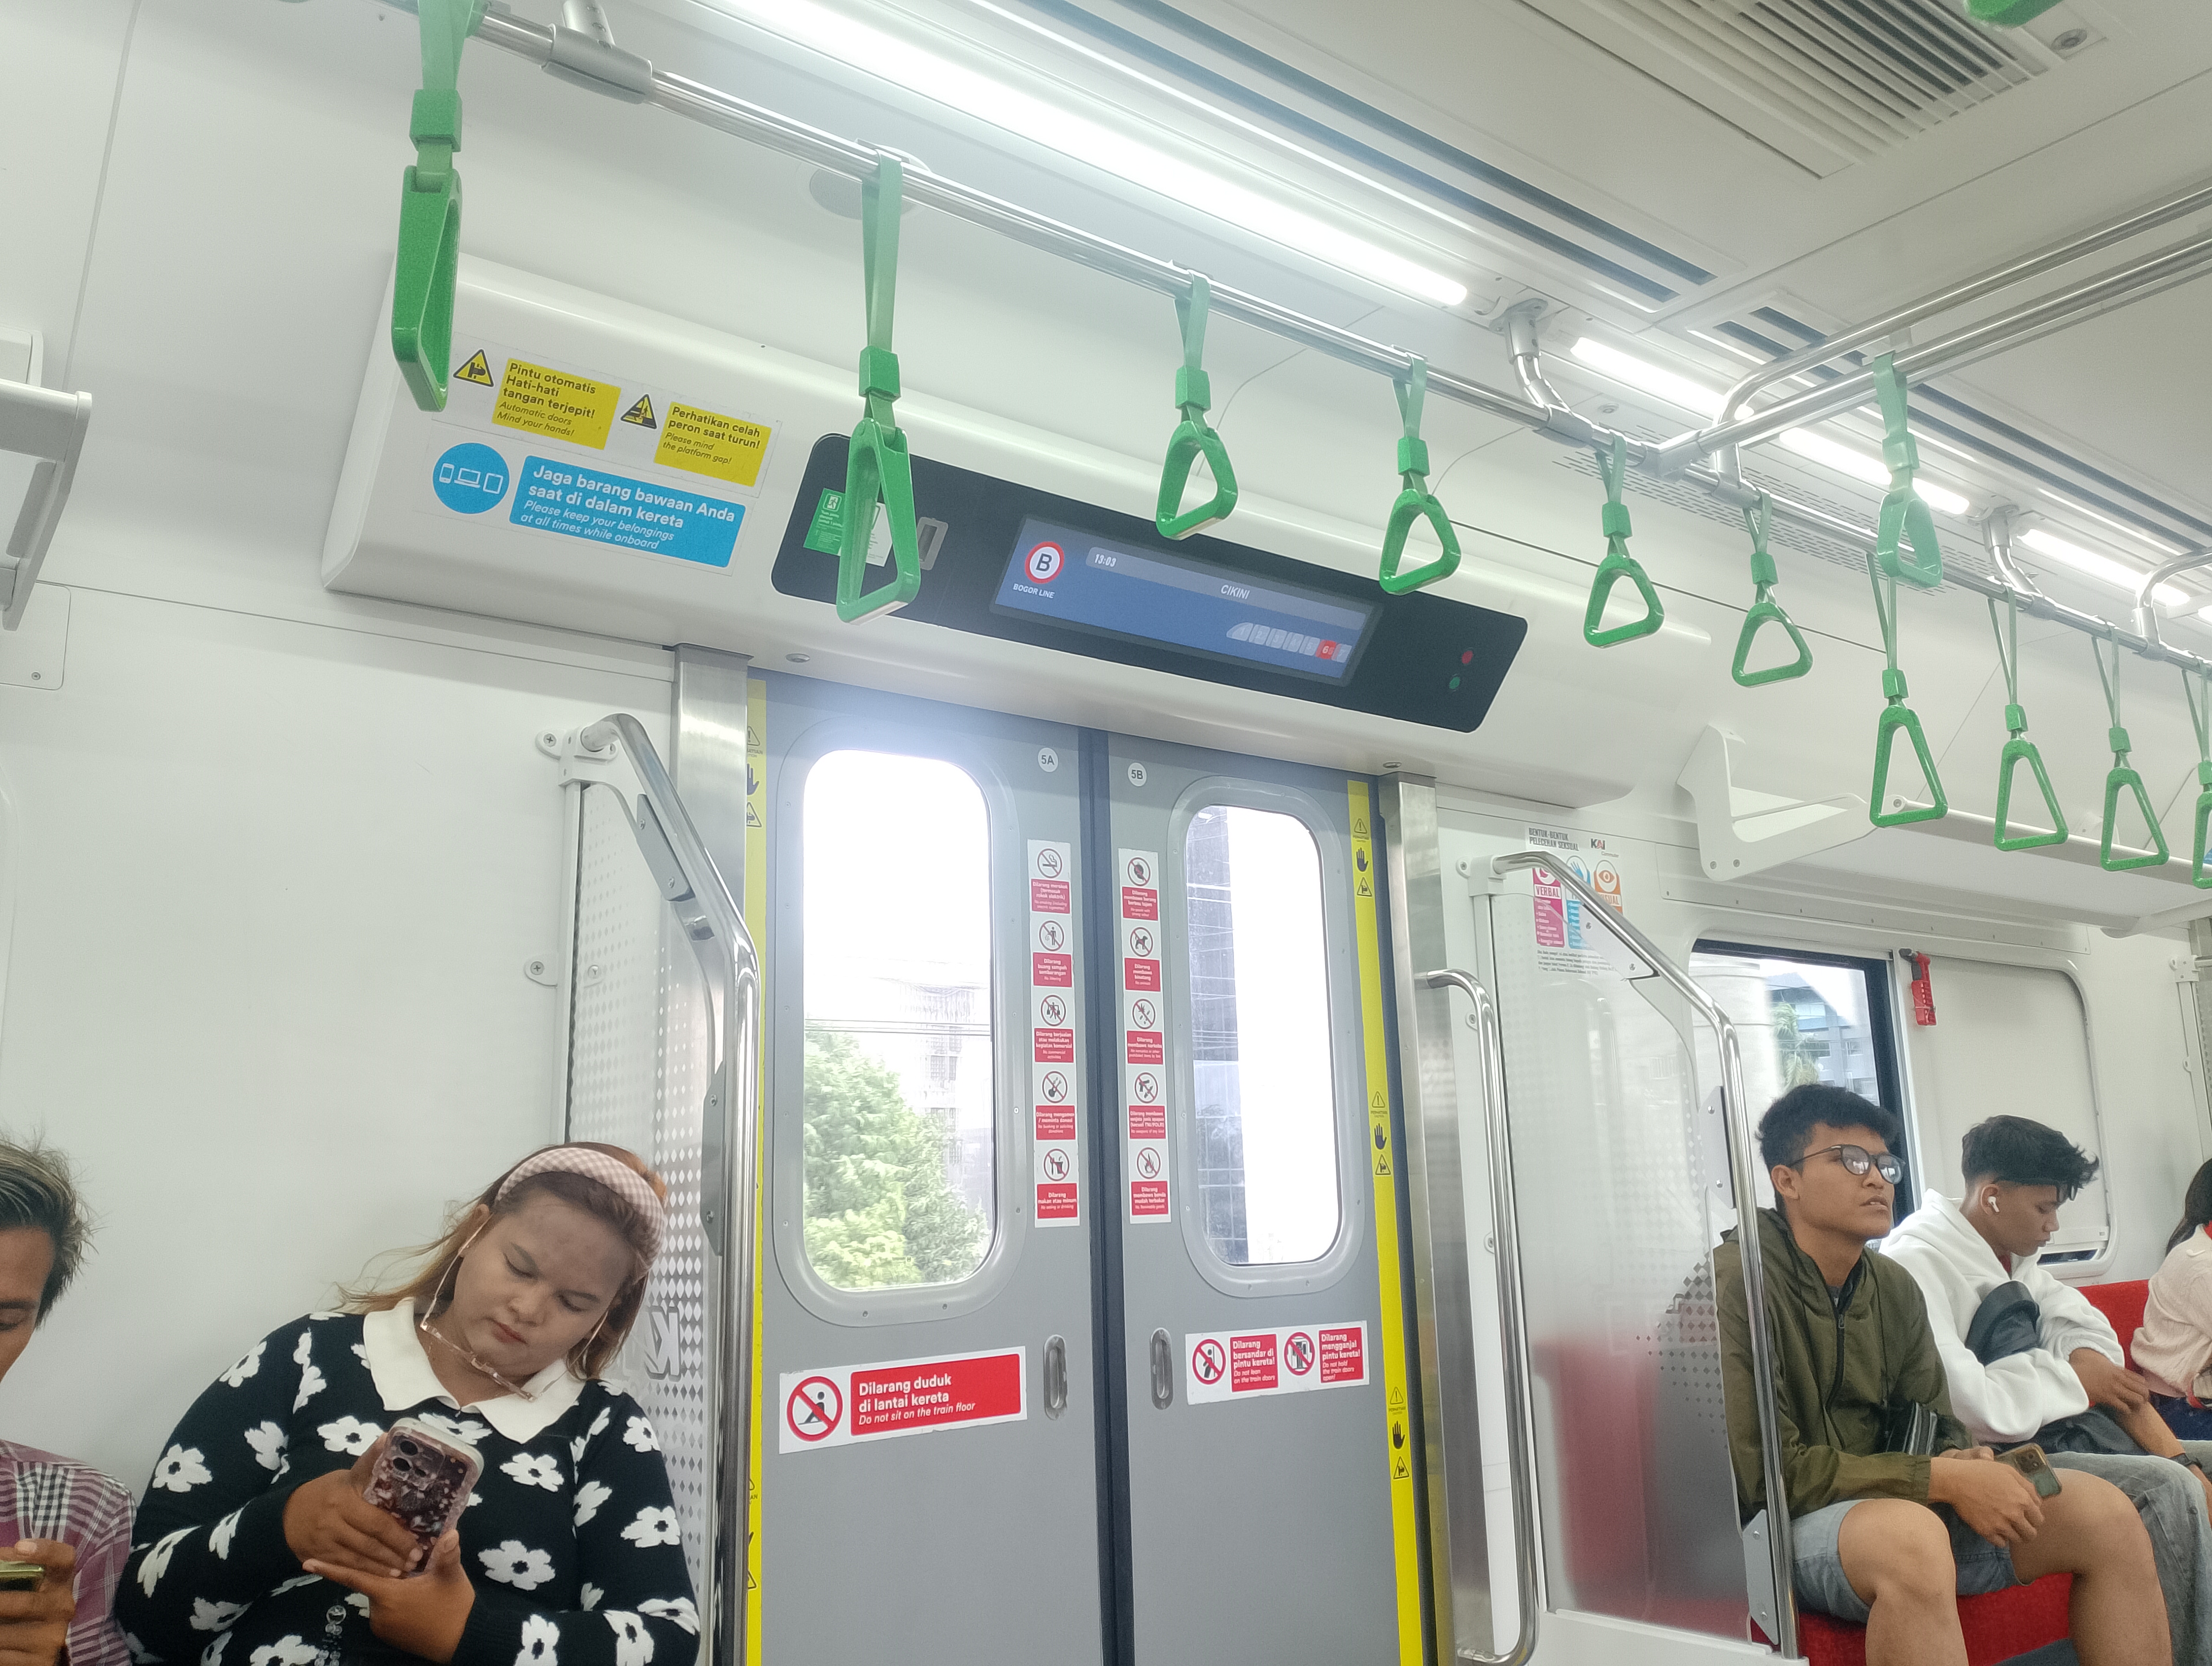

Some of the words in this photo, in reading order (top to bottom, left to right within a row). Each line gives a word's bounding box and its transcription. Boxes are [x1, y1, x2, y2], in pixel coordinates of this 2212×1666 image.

[506, 375, 560, 396] Hati-hati
[510, 363, 541, 380] Pintu
[544, 375, 596, 394] otomatis
[503, 387, 544, 406] tangan
[548, 399, 595, 419] terjepit!
[499, 401, 545, 419] Automatic
[548, 413, 573, 425] doors
[672, 407, 729, 430] Perhatikan
[732, 425, 760, 437] celah
[497, 412, 522, 423] Mind
[522, 420, 543, 428] your
[544, 423, 575, 437] hands!
[665, 432, 692, 445] Please
[693, 441, 715, 450] mind
[668, 420, 700, 434] peron
[703, 429, 725, 440] saat
[728, 434, 760, 449] turun!
[663, 442, 676, 450] the
[677, 446, 711, 459] platform
[712, 455, 732, 464] gap!
[533, 465, 573, 485] Jaga
[576, 474, 631, 501] barang
[635, 488, 693, 512] bawaan
[696, 502, 735, 522] Anda
[529, 486, 562, 501] saat
[566, 491, 582, 505] di
[586, 496, 632, 517] dalam
[635, 506, 683, 528] kereta
[524, 500, 561, 516] Please
[563, 509, 590, 523] keep
[591, 516, 616, 527] your
[618, 521, 674, 541] belongings
[520, 514, 533, 523] at
[535, 517, 551, 526] all
[552, 520, 581, 533] times
[584, 527, 612, 539] while
[615, 534, 660, 549] onboard
[1036, 553, 1052, 572] B
[1094, 554, 1116, 567] 13:03
[1013, 584, 1038, 595] BOGOR
[1039, 590, 1055, 599] LINE
[1221, 585, 1250, 600] CIKINI
[1322, 645, 1329, 654] 6
[1041, 755, 1055, 765] 5A
[1131, 769, 1143, 780] 5B
[1529, 836, 1557, 848] PELECEHAN
[1558, 841, 1579, 851] SEKSUAL
[1591, 838, 1605, 850] KAI
[1535, 887, 1560, 897] VERBAL
[1233, 1341, 1261, 1349] Dilarang
[1322, 1334, 1347, 1342] Dilarang
[1322, 1340, 1356, 1351] mengganjal
[1233, 1349, 1266, 1360] bersandar
[1268, 1348, 1274, 1356] di
[1322, 1351, 1338, 1362] pintu
[1233, 1360, 1251, 1370] pintu
[859, 1381, 911, 1396] Dilarang
[914, 1373, 951, 1389] duduk
[859, 1399, 871, 1412] di
[874, 1394, 908, 1411] lantai
[911, 1392, 949, 1406] kereta
[859, 1414, 872, 1425] Do
[874, 1413, 889, 1423] not
[891, 1410, 901, 1421] sit
[904, 1411, 914, 1419] on
[917, 1407, 931, 1417] the
[934, 1405, 953, 1415] train
[956, 1402, 976, 1412] floor
